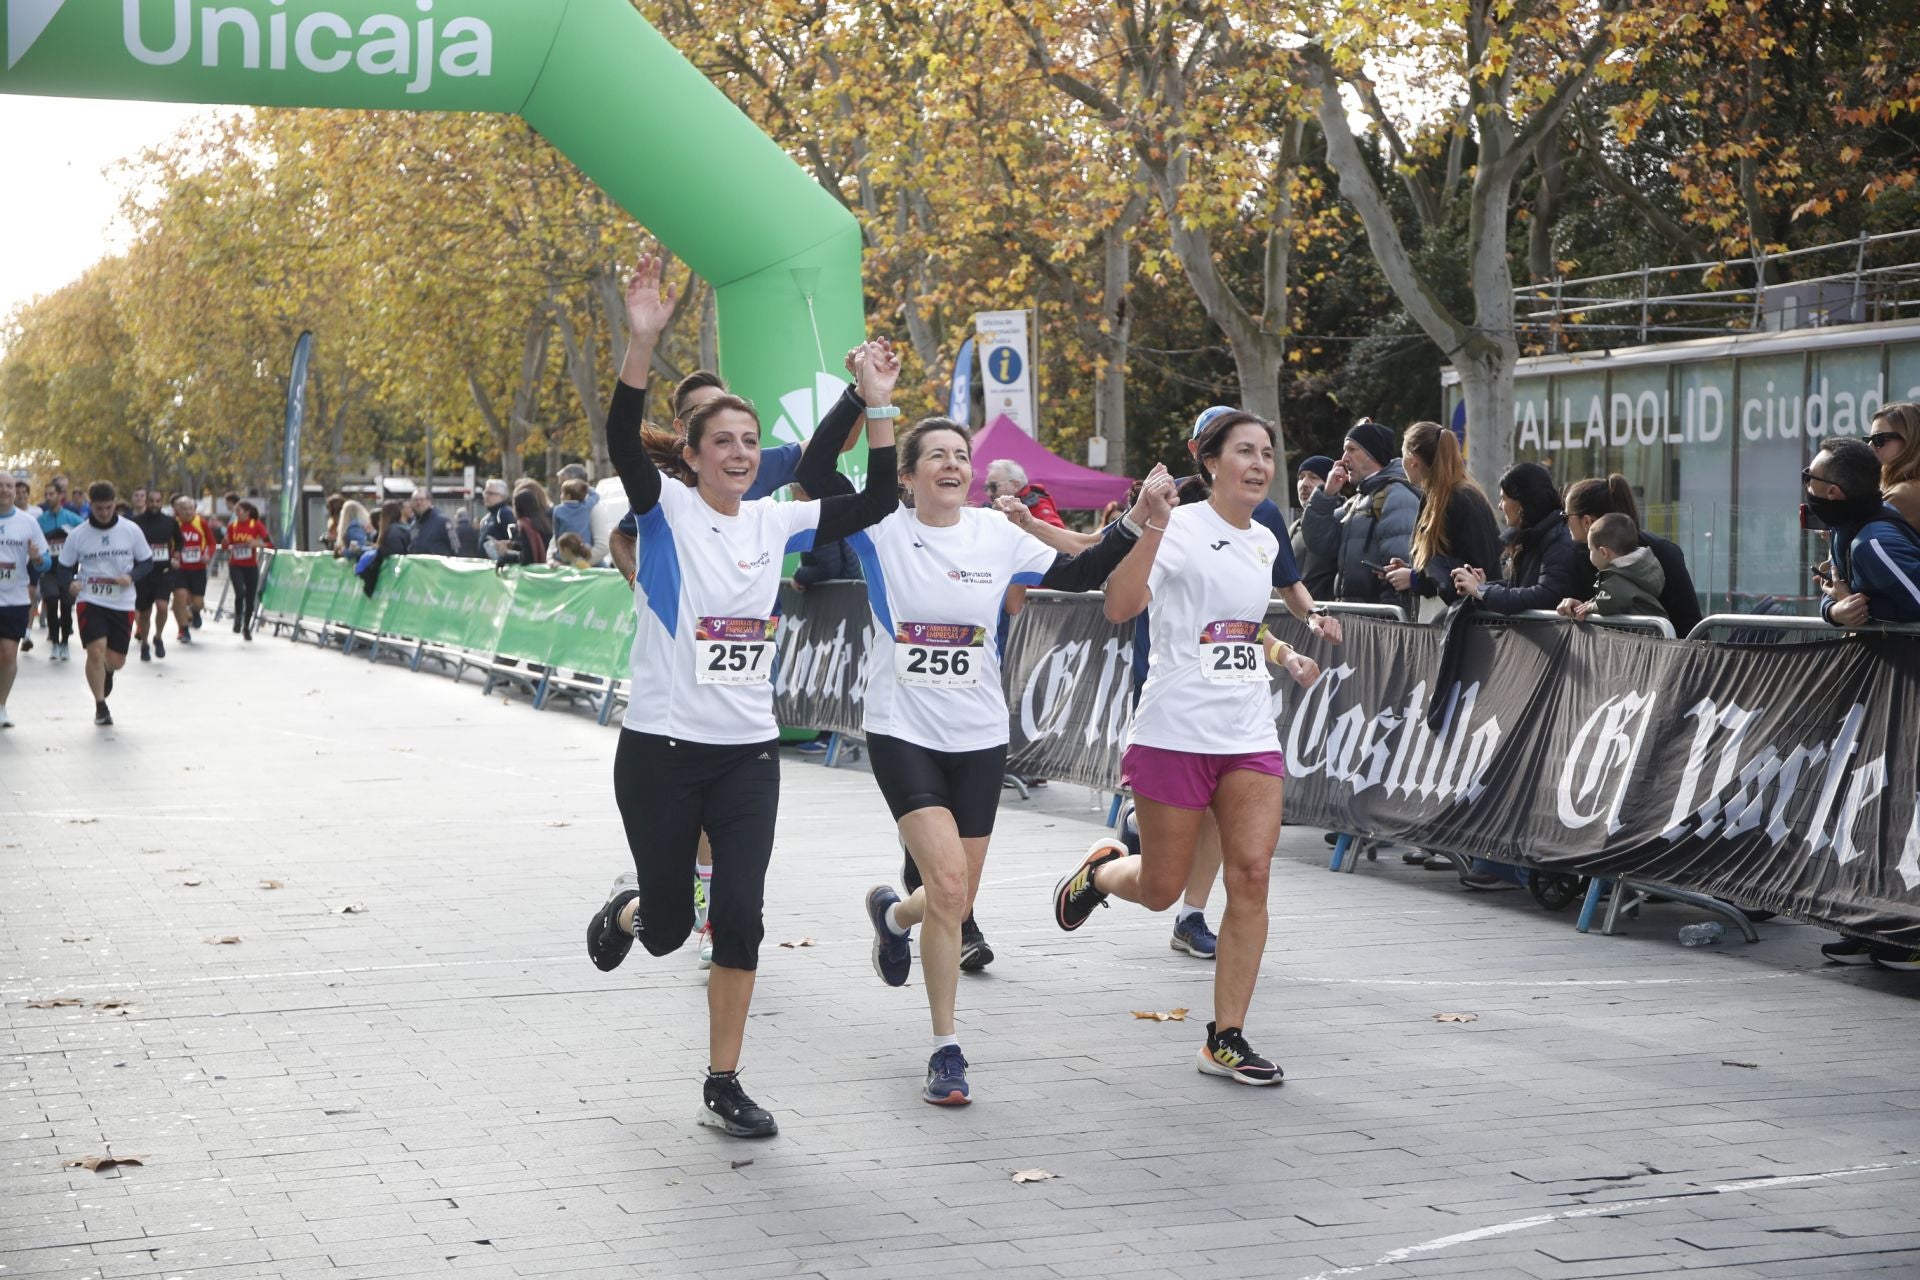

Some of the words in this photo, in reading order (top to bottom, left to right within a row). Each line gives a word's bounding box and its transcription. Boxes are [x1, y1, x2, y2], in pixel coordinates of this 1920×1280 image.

[122, 0, 493, 94] Unicaja
[1514, 386, 1724, 450] ALLADOLID
[1742, 372, 1884, 441] ciudad
[708, 643, 765, 671] 257
[906, 647, 970, 676] 256
[926, 631, 959, 639] EMPRESAS
[1212, 645, 1257, 671] 258
[1286, 661, 1502, 806] Castilla
[1557, 690, 1657, 836] El
[1659, 696, 1888, 867] Norte
